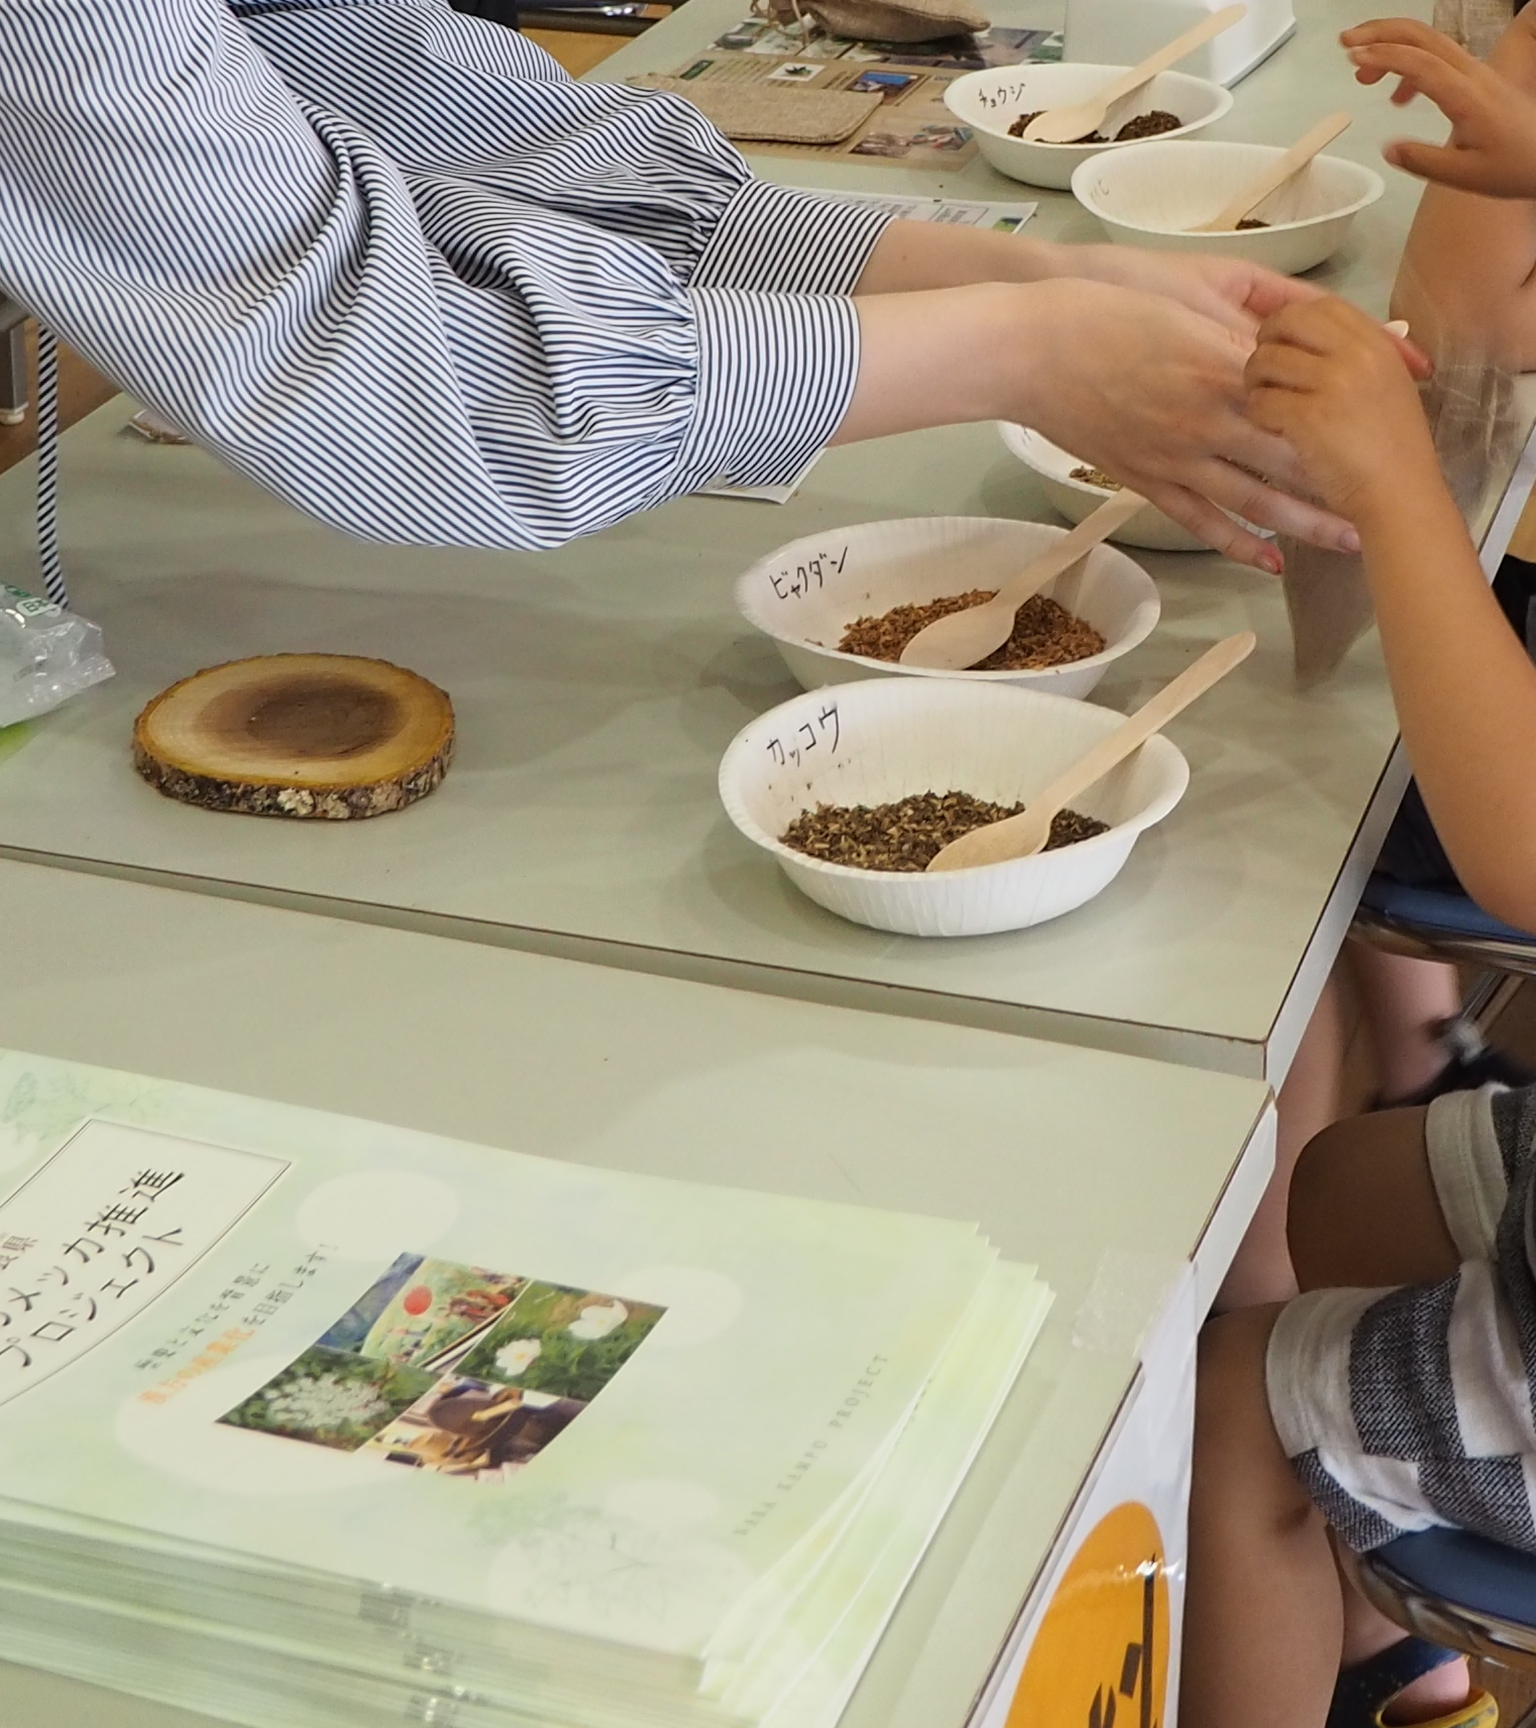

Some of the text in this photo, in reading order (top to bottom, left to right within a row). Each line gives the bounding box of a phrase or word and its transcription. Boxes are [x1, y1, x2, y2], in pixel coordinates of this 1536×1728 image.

[978, 83, 1026, 109] チョウジ
[768, 545, 850, 601] ビャクダン
[766, 699, 843, 769] カッコウ
